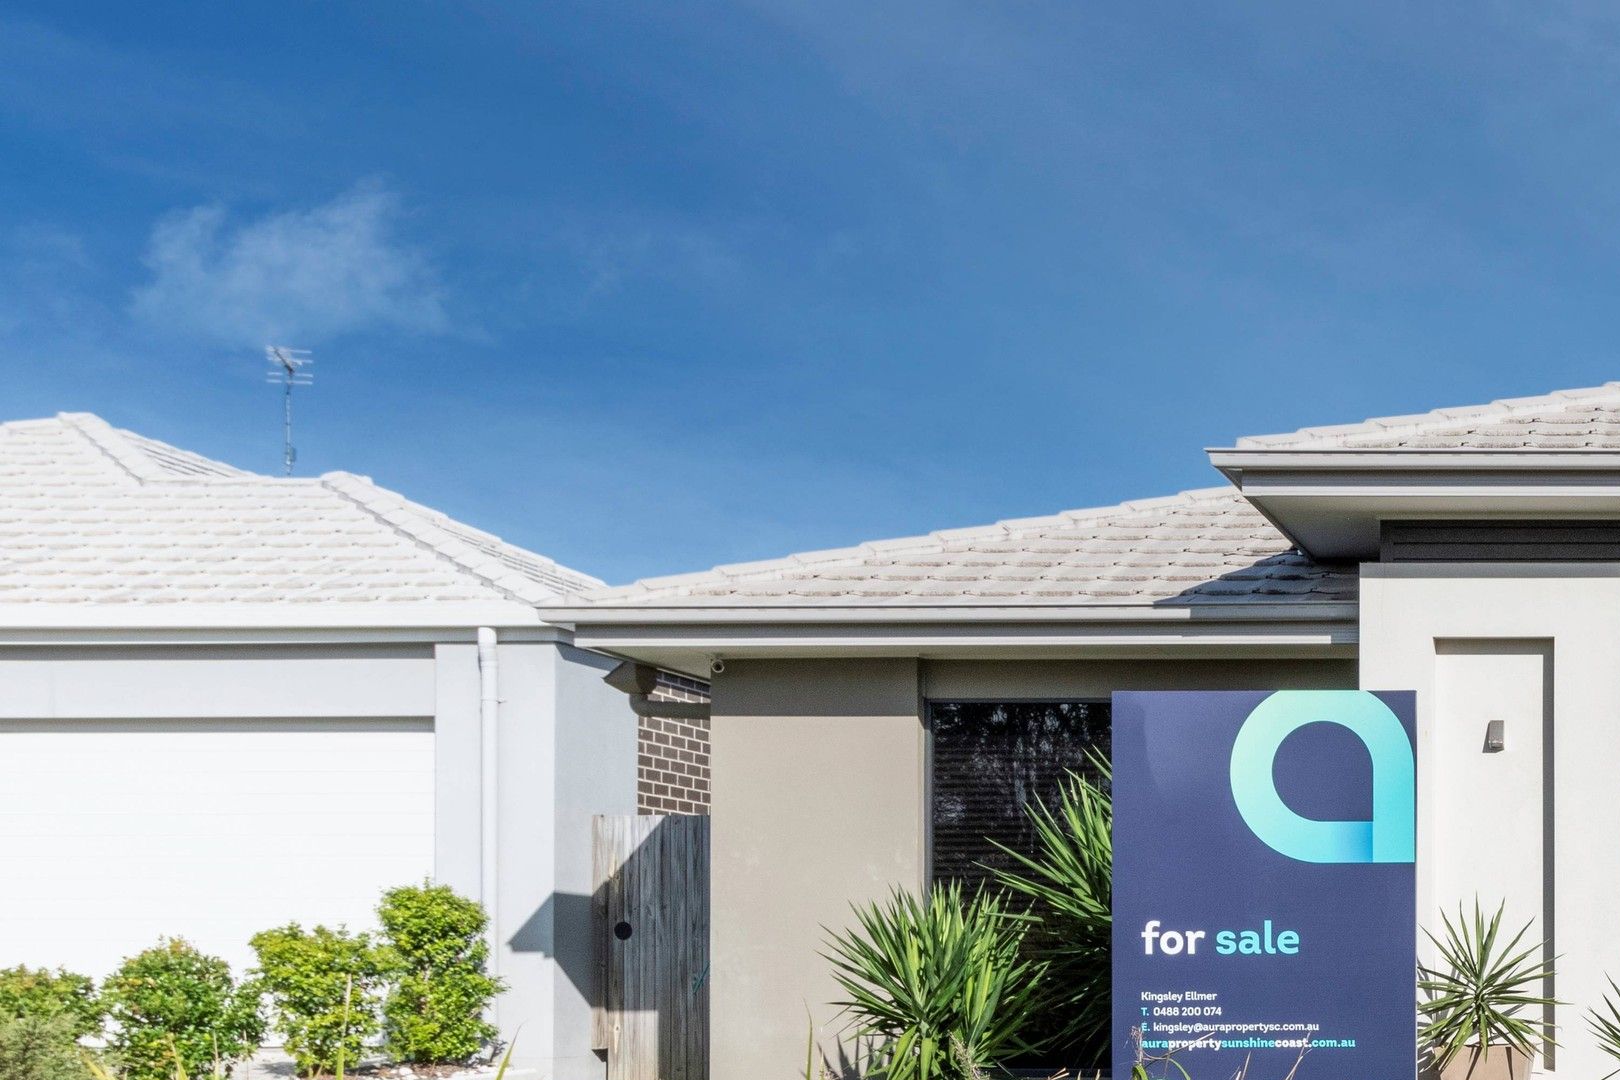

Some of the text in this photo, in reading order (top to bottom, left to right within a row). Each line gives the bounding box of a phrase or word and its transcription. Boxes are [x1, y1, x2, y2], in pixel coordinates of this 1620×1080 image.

[1141, 920, 1300, 956] for sale
[1141, 991, 1217, 1003] Kingsley Ellmer
[1141, 1007, 1222, 1016] T. 0488 200 074
[1141, 1022, 1319, 1033] E. kingsley@aurapropertysc.com.au
[1141, 1037, 1355, 1051] aurapropertysunshinecoast.com.au
